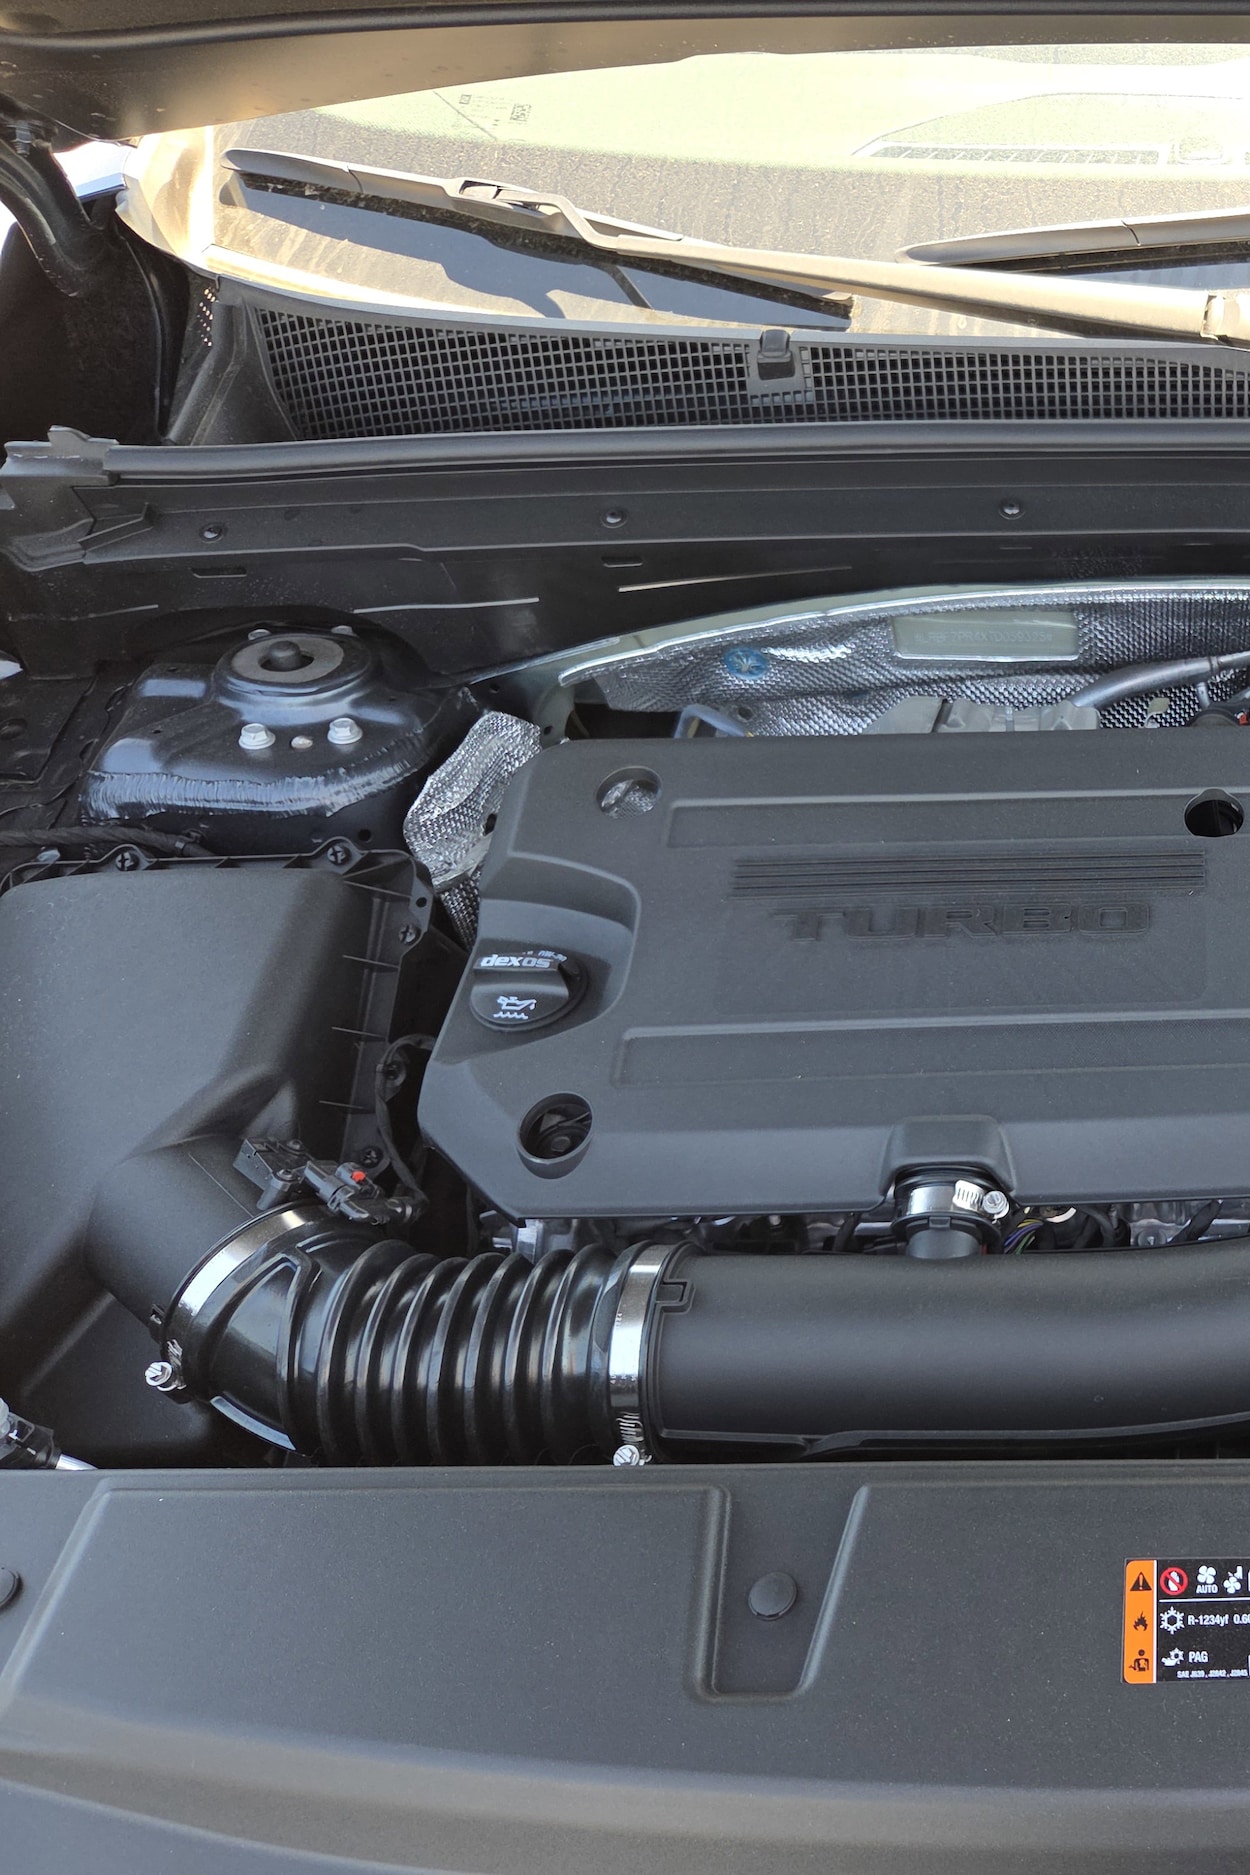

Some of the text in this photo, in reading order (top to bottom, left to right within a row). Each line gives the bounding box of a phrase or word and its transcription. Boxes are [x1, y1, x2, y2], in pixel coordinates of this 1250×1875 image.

[773, 902, 1151, 942] TURBO
[1196, 1584, 1218, 1594] AUTO
[1188, 1614, 1229, 1626] R-1234yf
[1188, 1651, 1209, 1663] PAG
